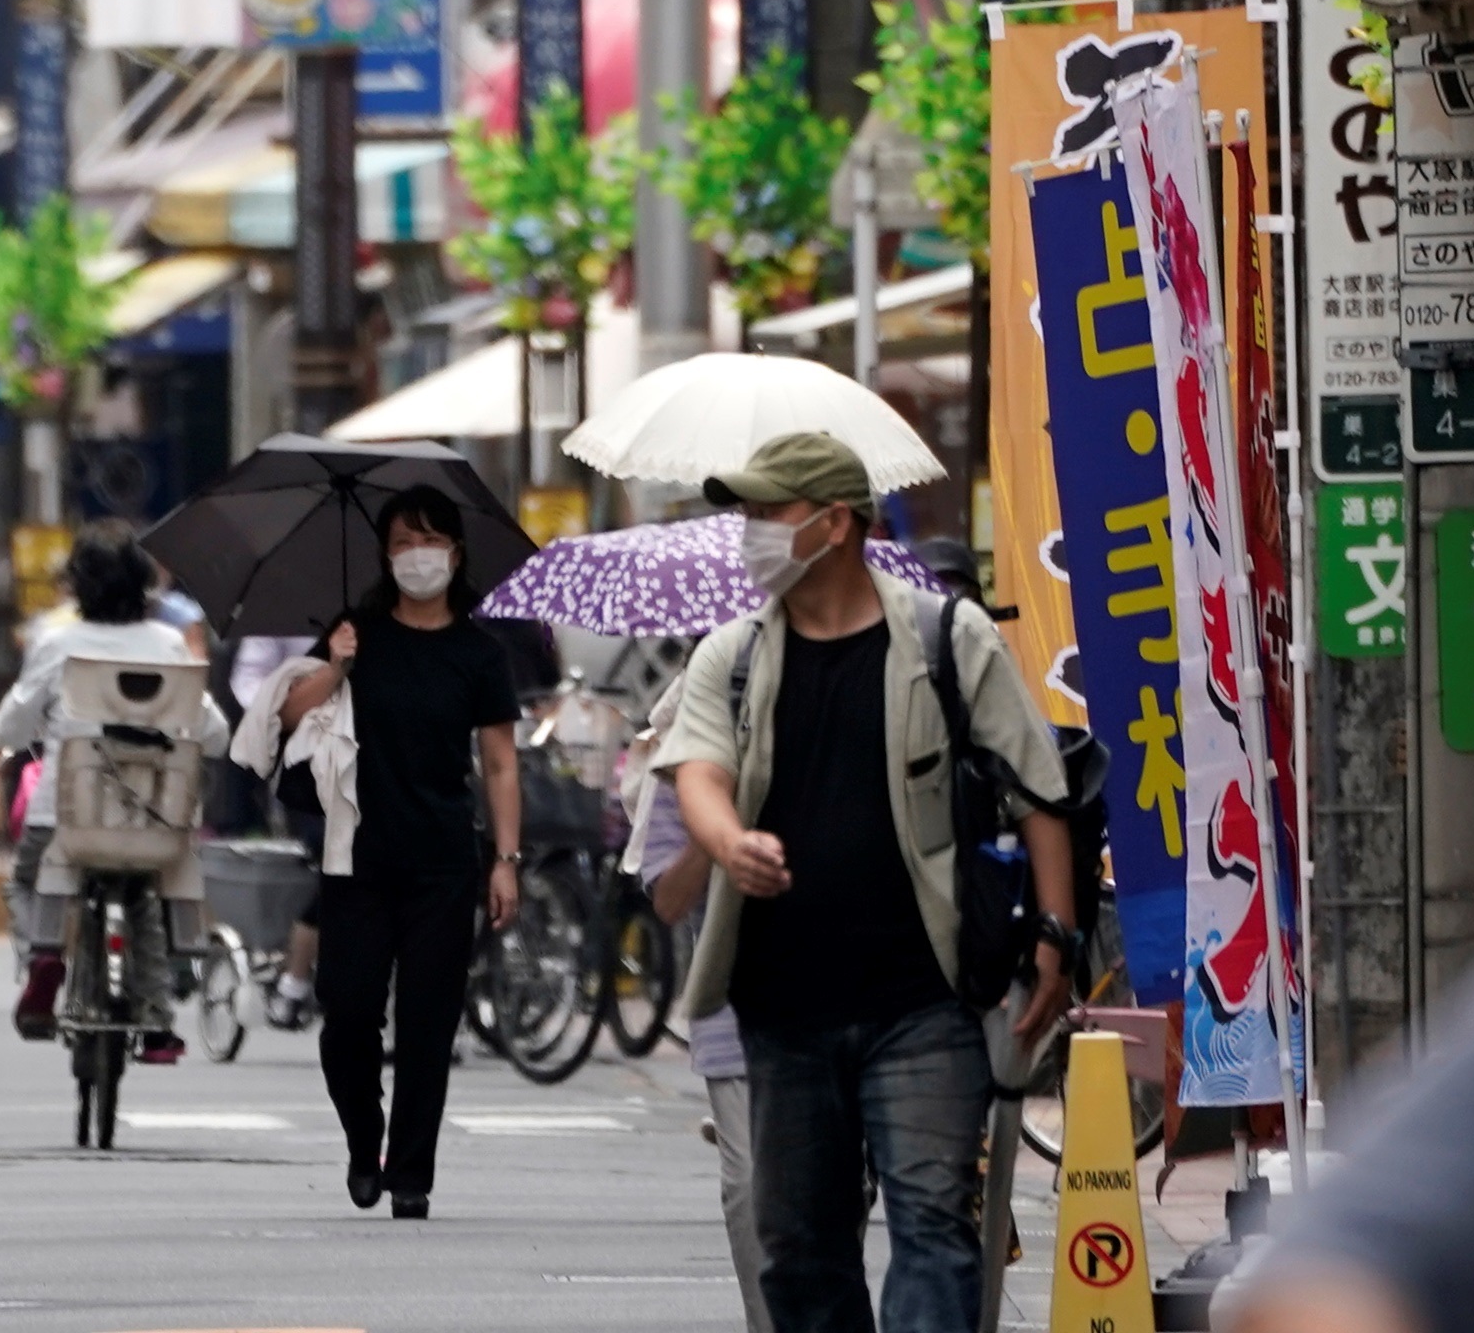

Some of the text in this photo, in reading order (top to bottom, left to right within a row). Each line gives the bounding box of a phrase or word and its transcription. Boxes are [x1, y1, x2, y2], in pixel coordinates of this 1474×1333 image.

[1331, 337, 1385, 352] さのや
[1344, 532, 1406, 626] 文
[1066, 1170, 1132, 1192] NO PARKING
